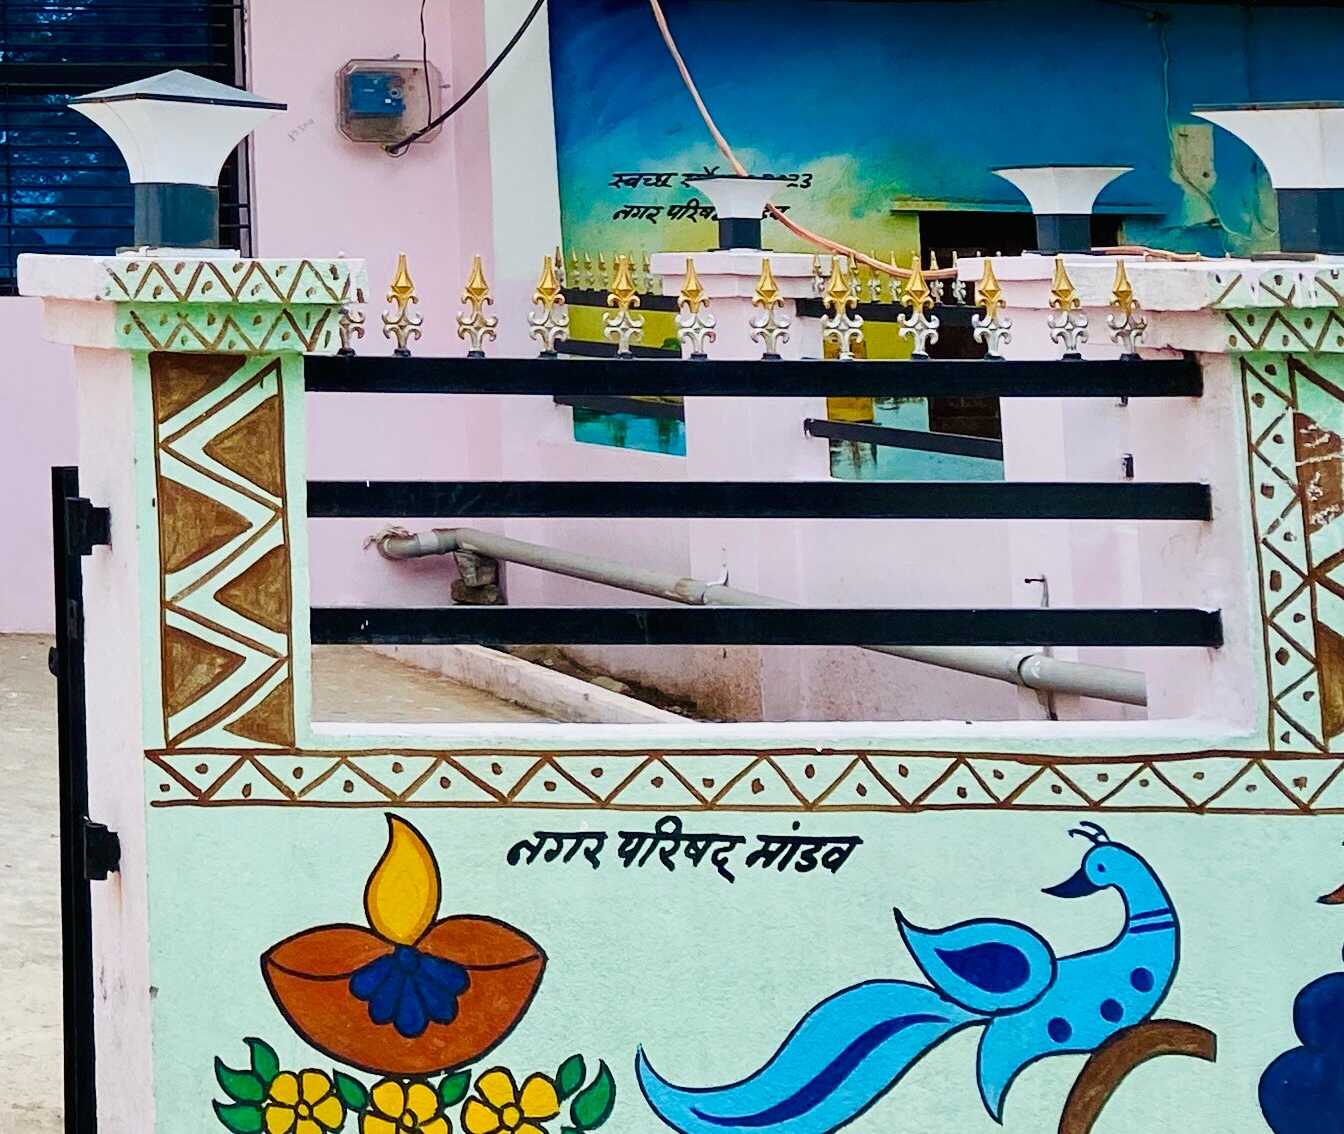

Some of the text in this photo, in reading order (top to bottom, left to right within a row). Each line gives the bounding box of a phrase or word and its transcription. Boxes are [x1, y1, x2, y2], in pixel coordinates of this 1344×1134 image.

[507, 815, 863, 883] नगर परिषद् मांडव
